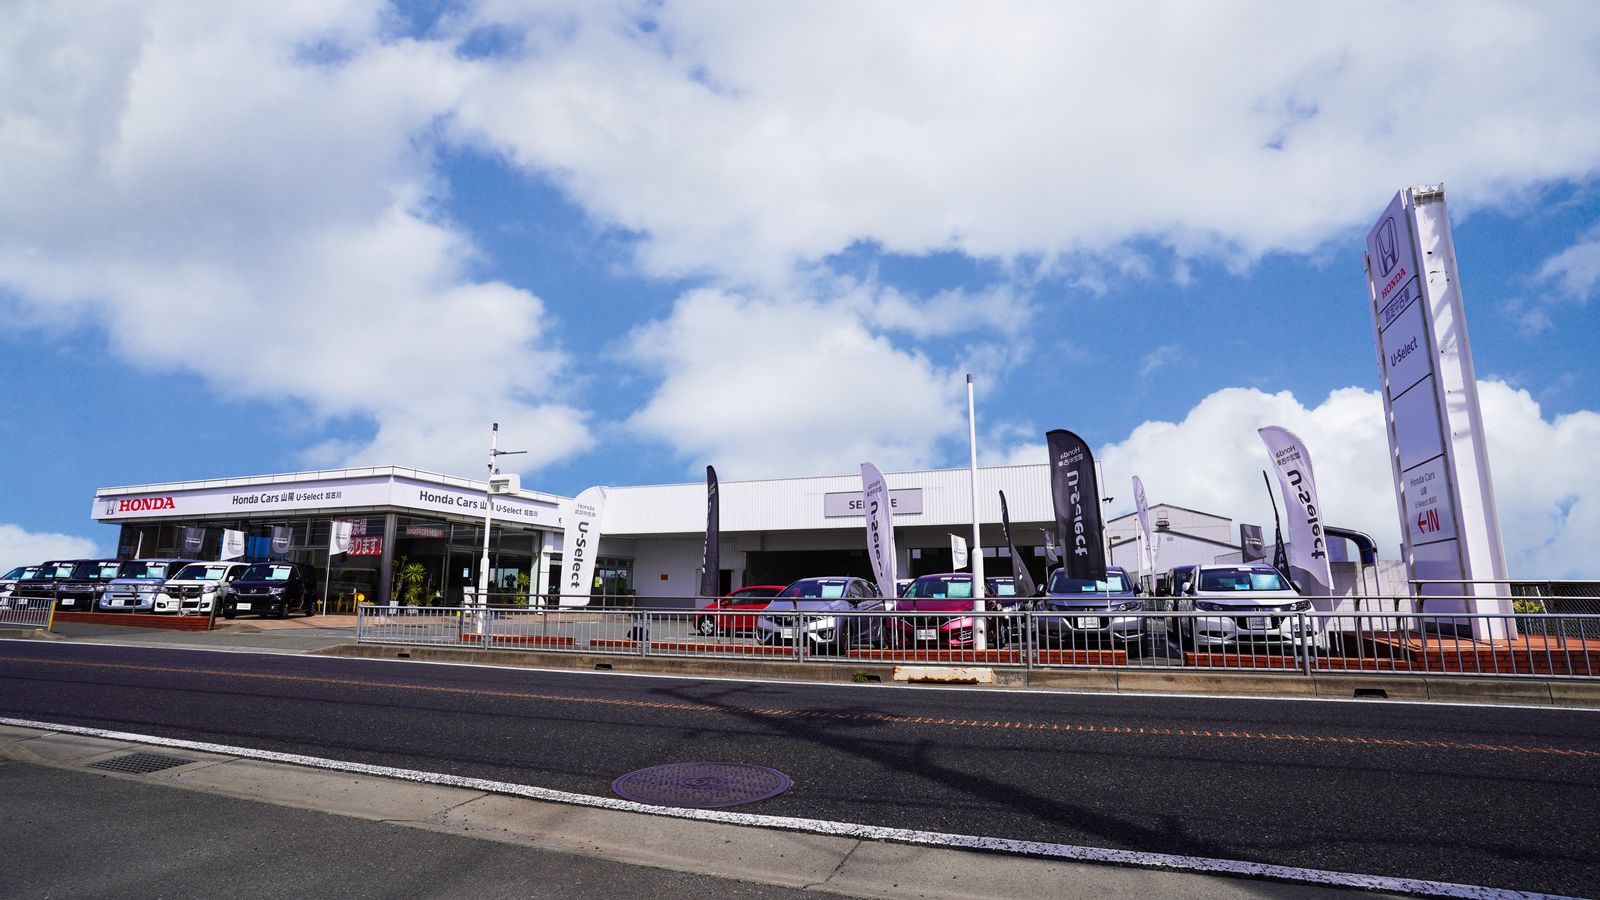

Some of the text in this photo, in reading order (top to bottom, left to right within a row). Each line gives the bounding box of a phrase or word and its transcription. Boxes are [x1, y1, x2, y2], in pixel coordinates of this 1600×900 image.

[1381, 267, 1406, 300] HONDA
[1390, 335, 1418, 367] U-Select
[1410, 471, 1436, 487] Honda Cars
[118, 497, 176, 512] HONDA
[232, 494, 259, 505] Honda
[260, 493, 279, 504] Cars
[296, 492, 324, 501] U-Select
[419, 490, 454, 505] Honda
[456, 496, 478, 509] Cars
[496, 504, 522, 516] U-Select
[577, 503, 595, 511] Honda
[1426, 508, 1440, 533] IN
[570, 521, 589, 589] U-Select
